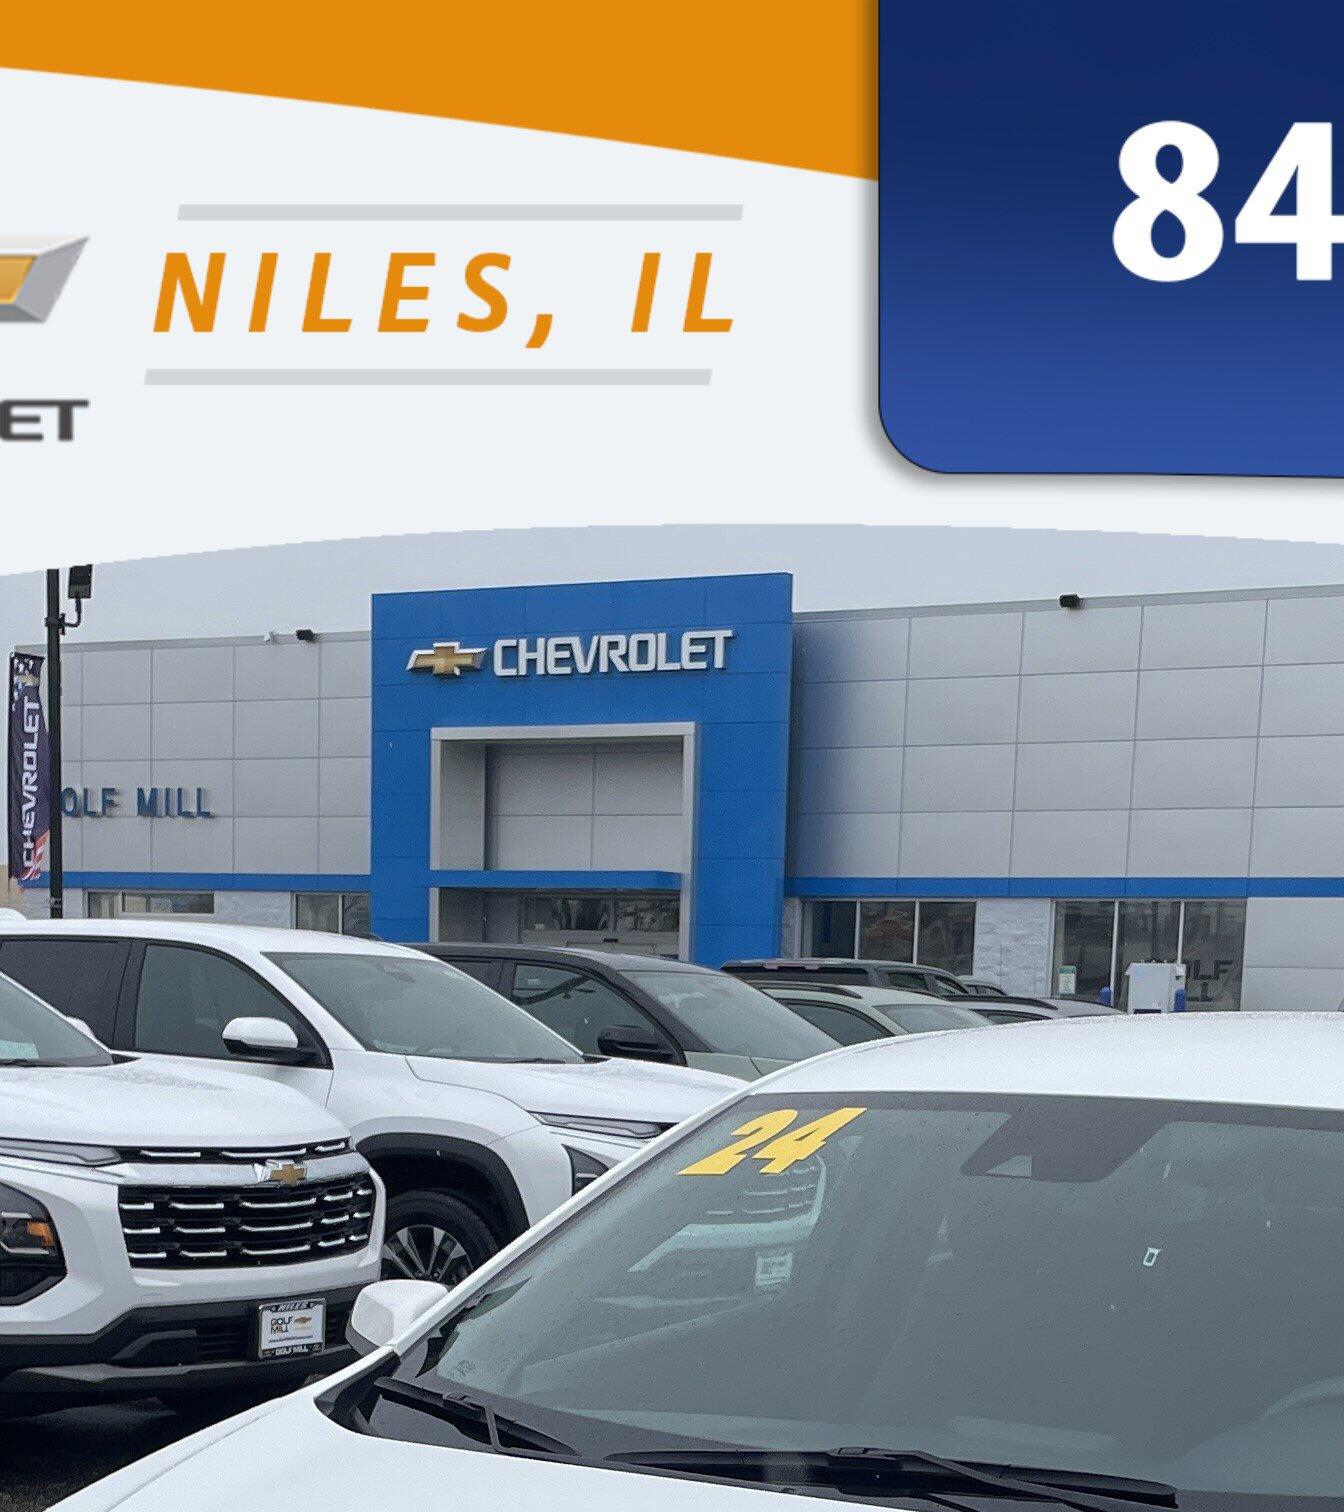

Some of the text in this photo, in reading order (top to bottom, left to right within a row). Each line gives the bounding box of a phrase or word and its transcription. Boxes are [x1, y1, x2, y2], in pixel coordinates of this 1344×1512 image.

[493, 629, 733, 677] CHEVROLET
[61, 787, 215, 818] OLF MILL
[676, 1107, 868, 1176] 24
